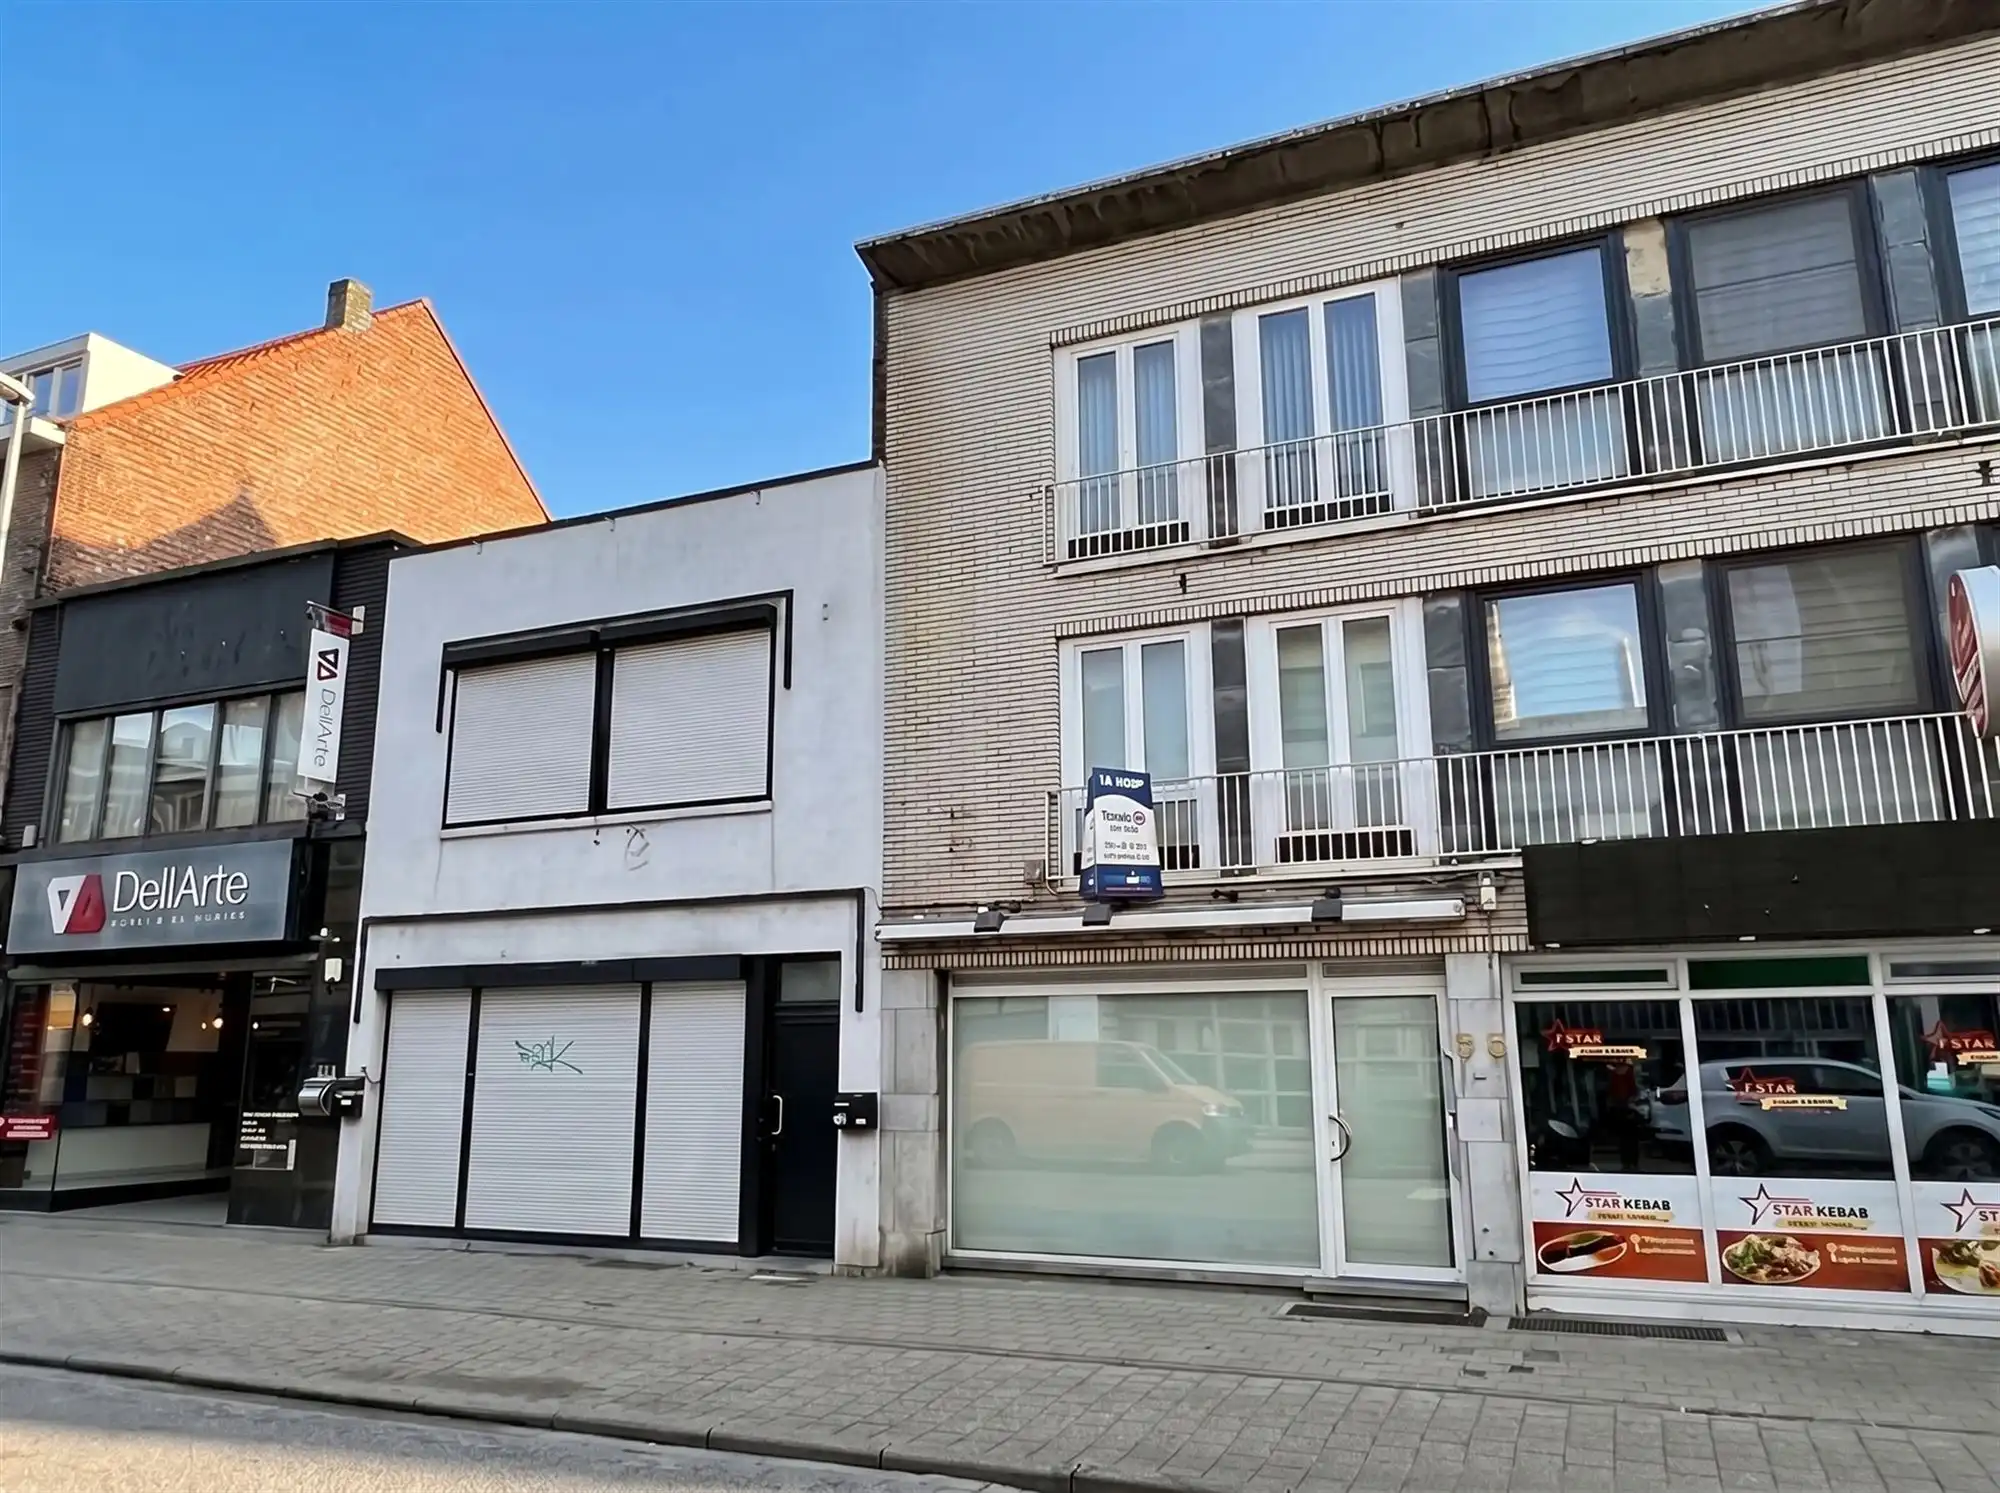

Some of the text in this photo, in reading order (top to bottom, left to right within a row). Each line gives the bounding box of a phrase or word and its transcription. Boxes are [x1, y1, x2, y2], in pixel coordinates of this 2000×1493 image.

[314, 688, 336, 767] DellArte
[113, 865, 249, 913] DellArte
[1585, 1197, 1671, 1211] STAR KEBAB
[1773, 1204, 1868, 1219] STAR KEBAB
